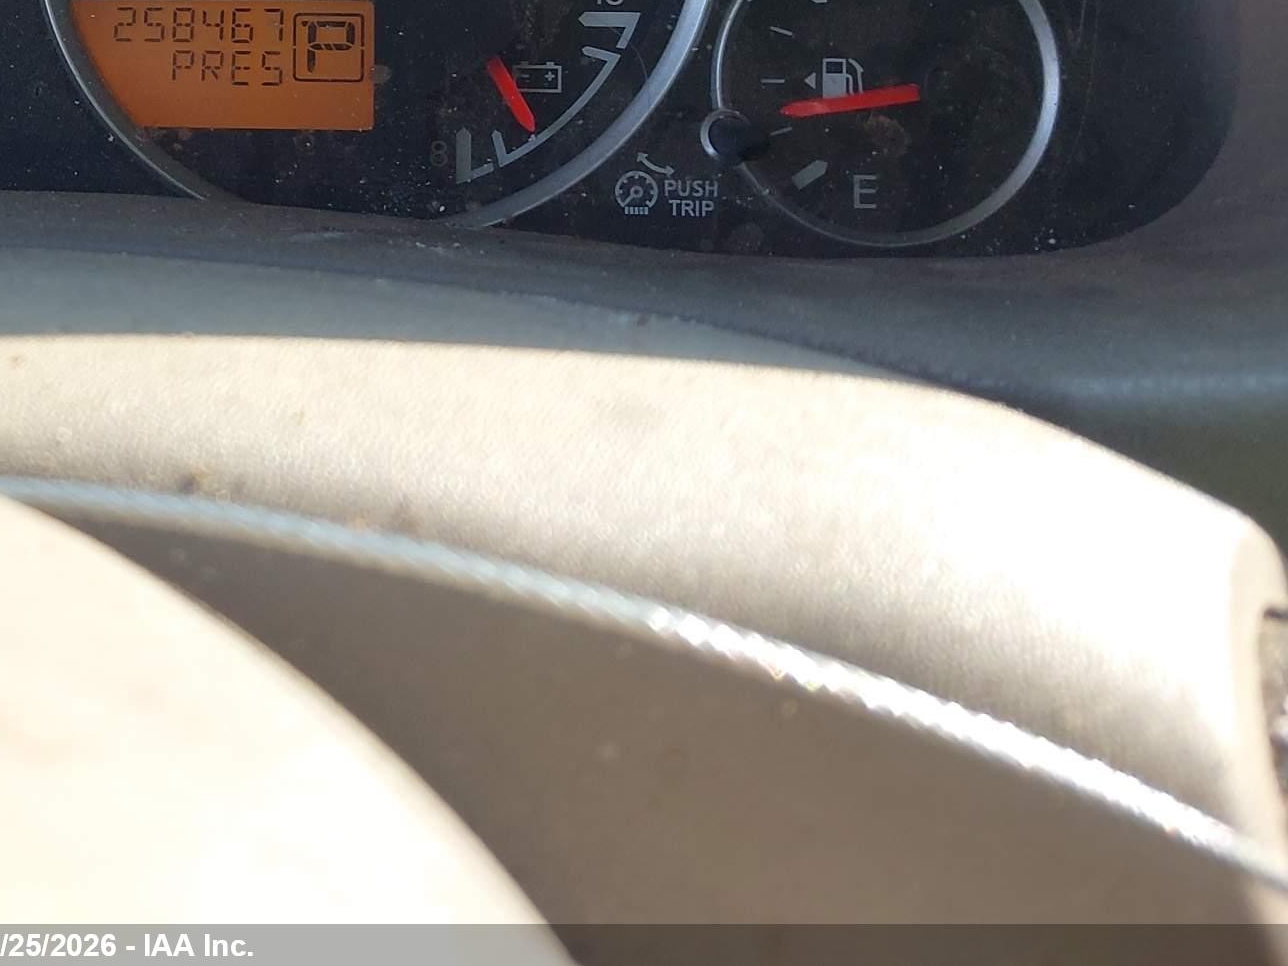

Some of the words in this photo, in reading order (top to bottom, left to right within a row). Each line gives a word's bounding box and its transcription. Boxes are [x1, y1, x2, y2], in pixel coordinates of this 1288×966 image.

[113, 7, 284, 43] 258467
[301, 21, 355, 73] P
[172, 50, 283, 86] PRES
[430, 141, 448, 167] 8
[664, 180, 719, 198] PUSH
[853, 175, 877, 209] E
[669, 199, 715, 218] TRIP
